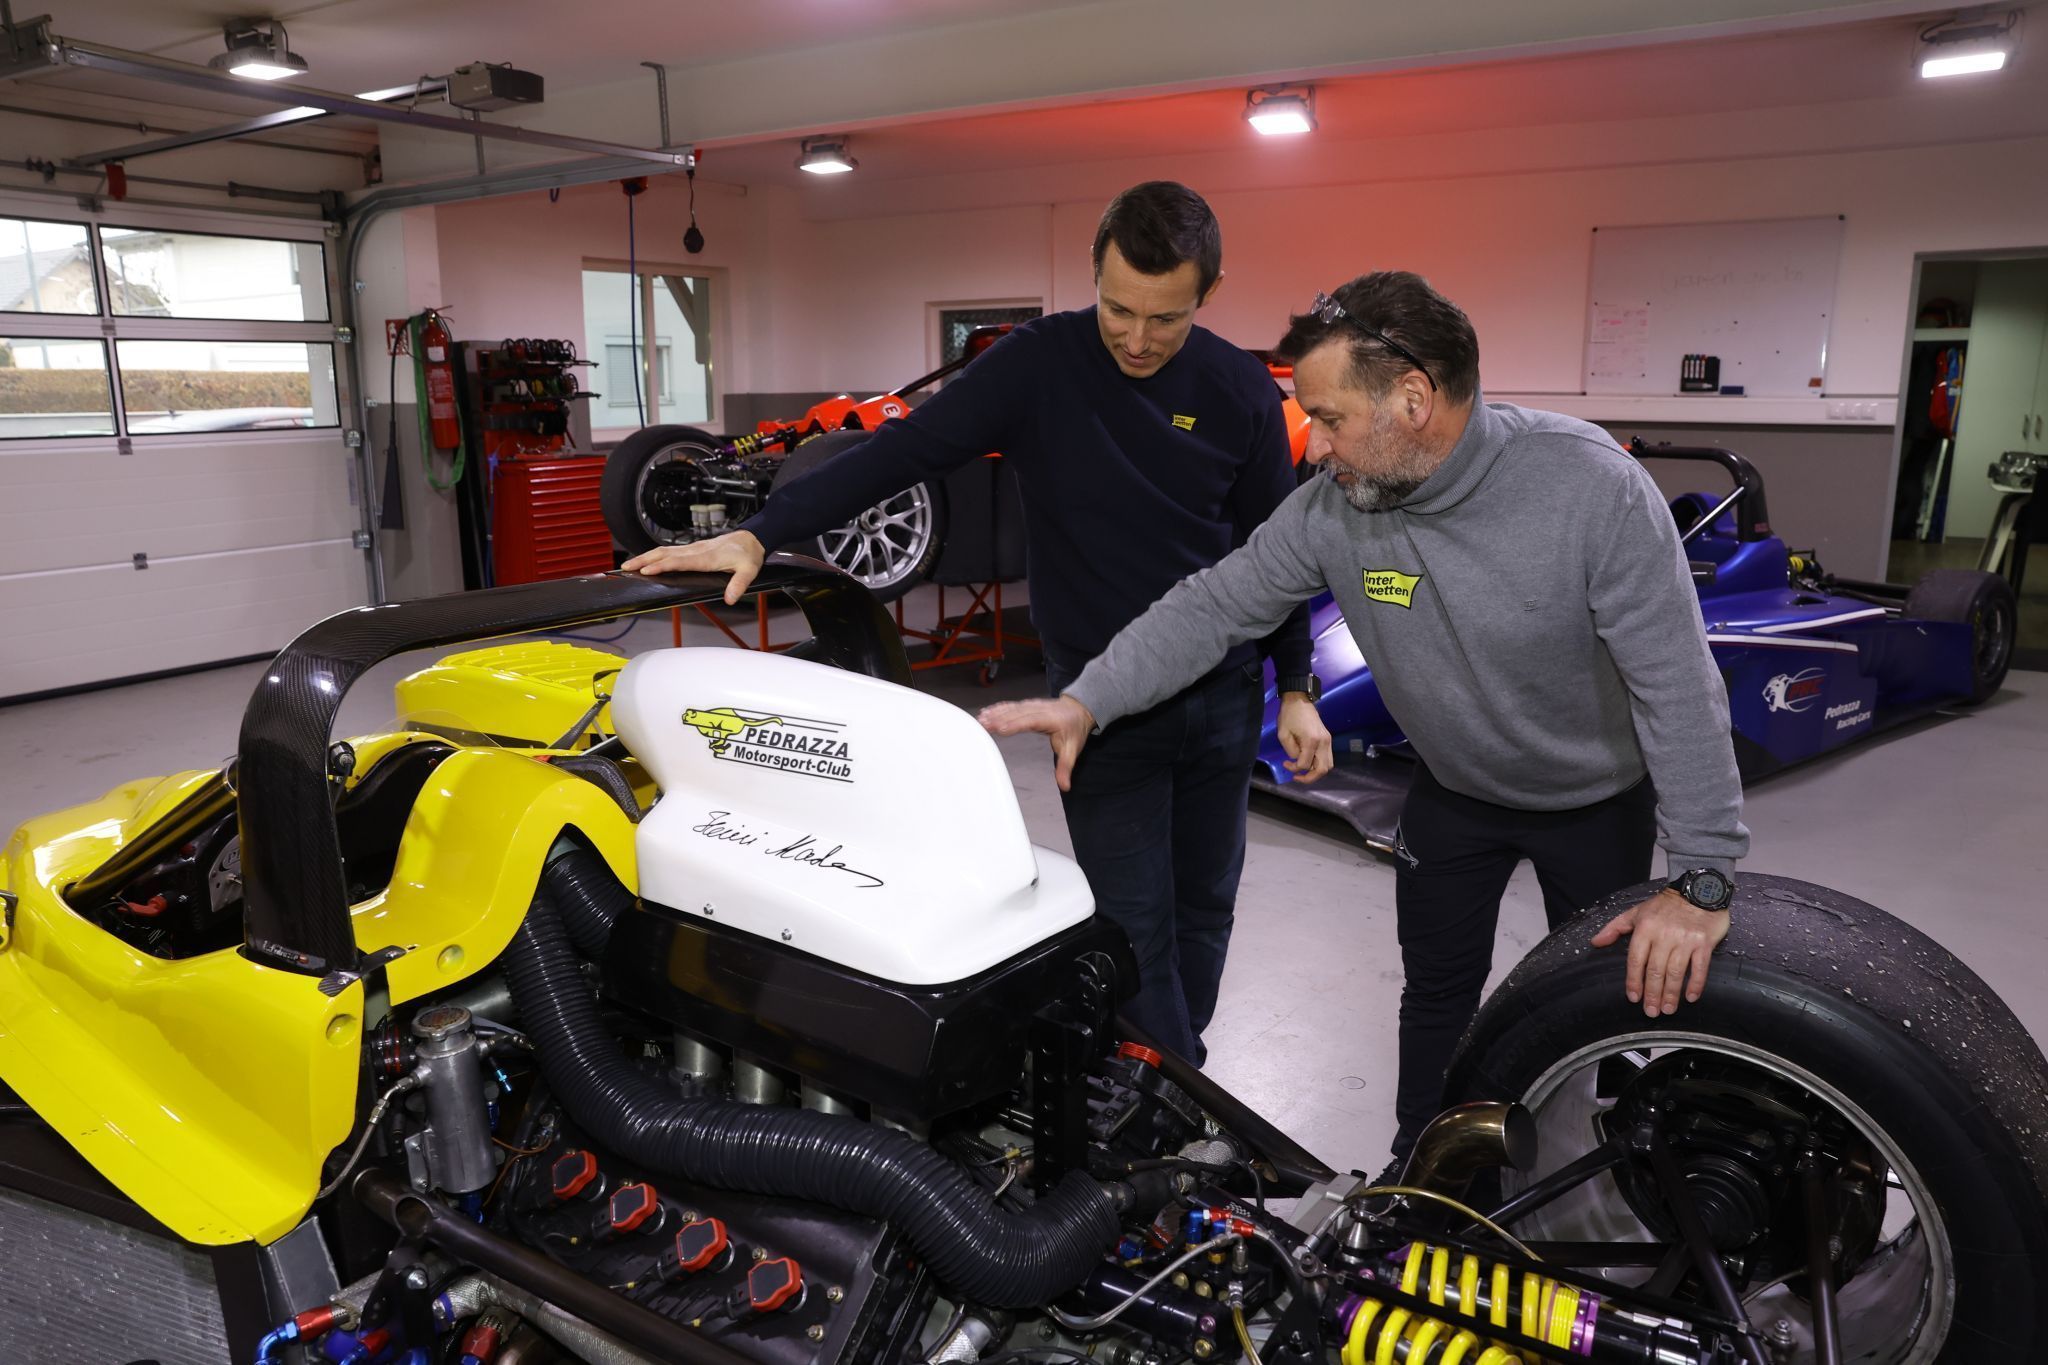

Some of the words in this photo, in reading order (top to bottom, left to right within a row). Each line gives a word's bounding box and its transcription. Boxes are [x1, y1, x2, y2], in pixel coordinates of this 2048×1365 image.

[885, 406, 898, 415] E
[1365, 573, 1395, 586] inter
[1367, 585, 1409, 597] wetten
[1825, 700, 1861, 720] Pedrazza
[1836, 716, 1858, 730] Racing
[1857, 711, 1871, 723] Cars
[745, 727, 850, 758] PEDRAZZA
[733, 745, 852, 778] Motorsport-Club
